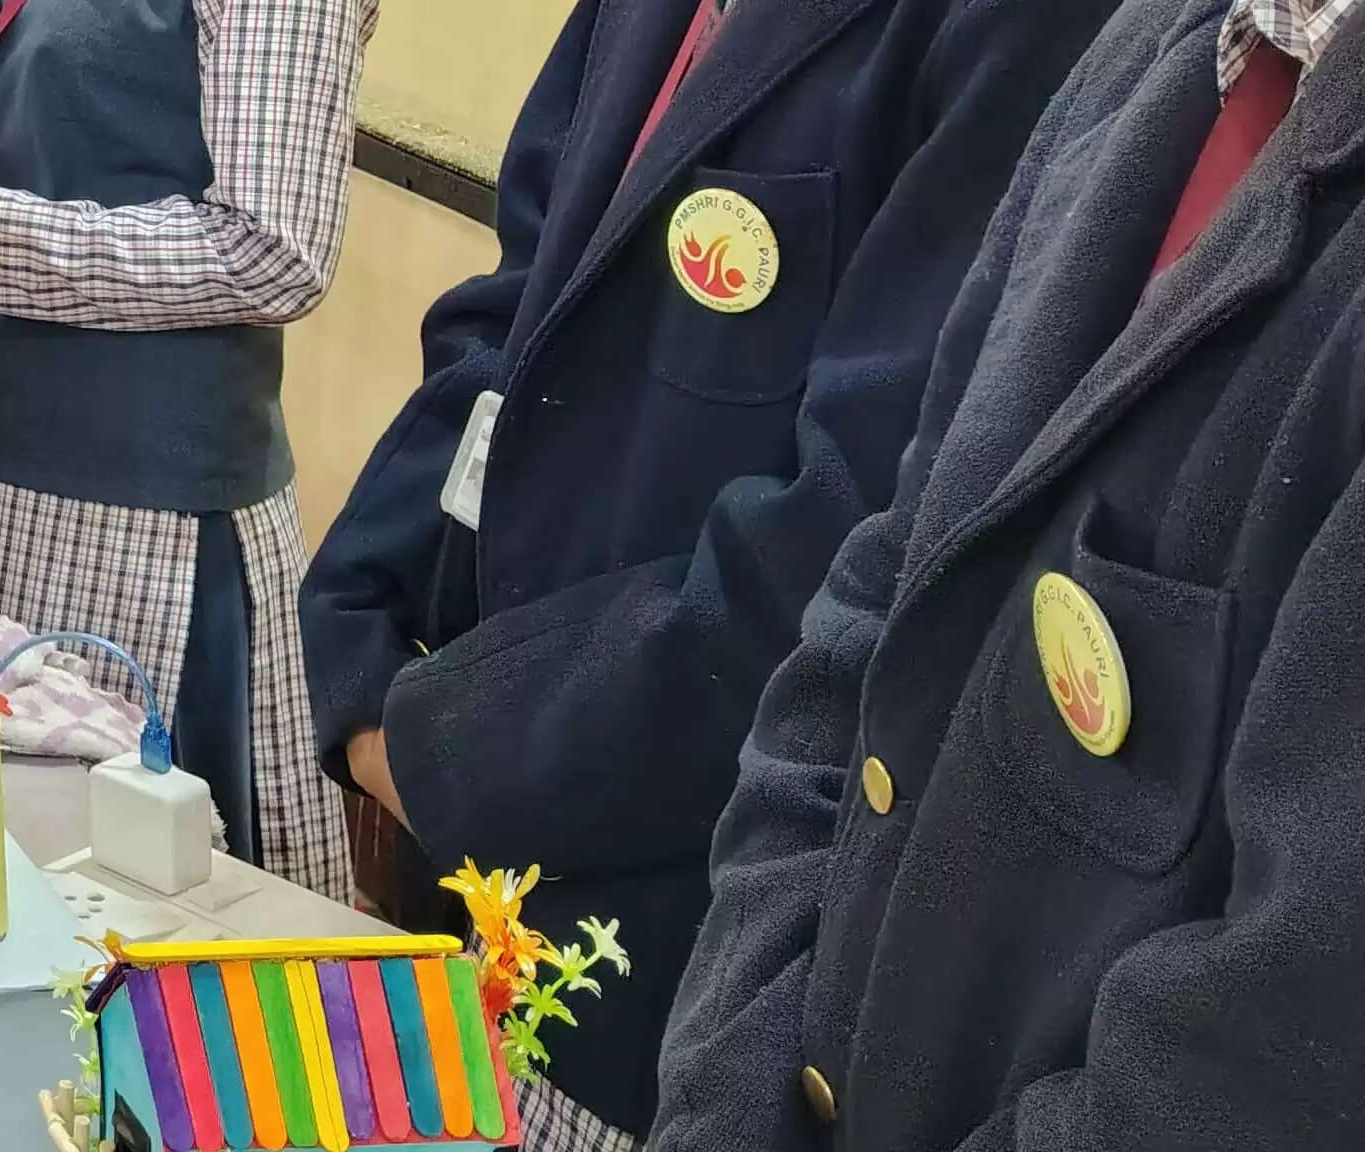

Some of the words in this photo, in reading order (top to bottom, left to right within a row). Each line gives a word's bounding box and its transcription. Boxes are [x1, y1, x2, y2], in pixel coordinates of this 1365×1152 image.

[675, 196, 719, 230] PMSHRI
[752, 247, 770, 294] PAURI
[1077, 610, 1110, 679] PAURI
